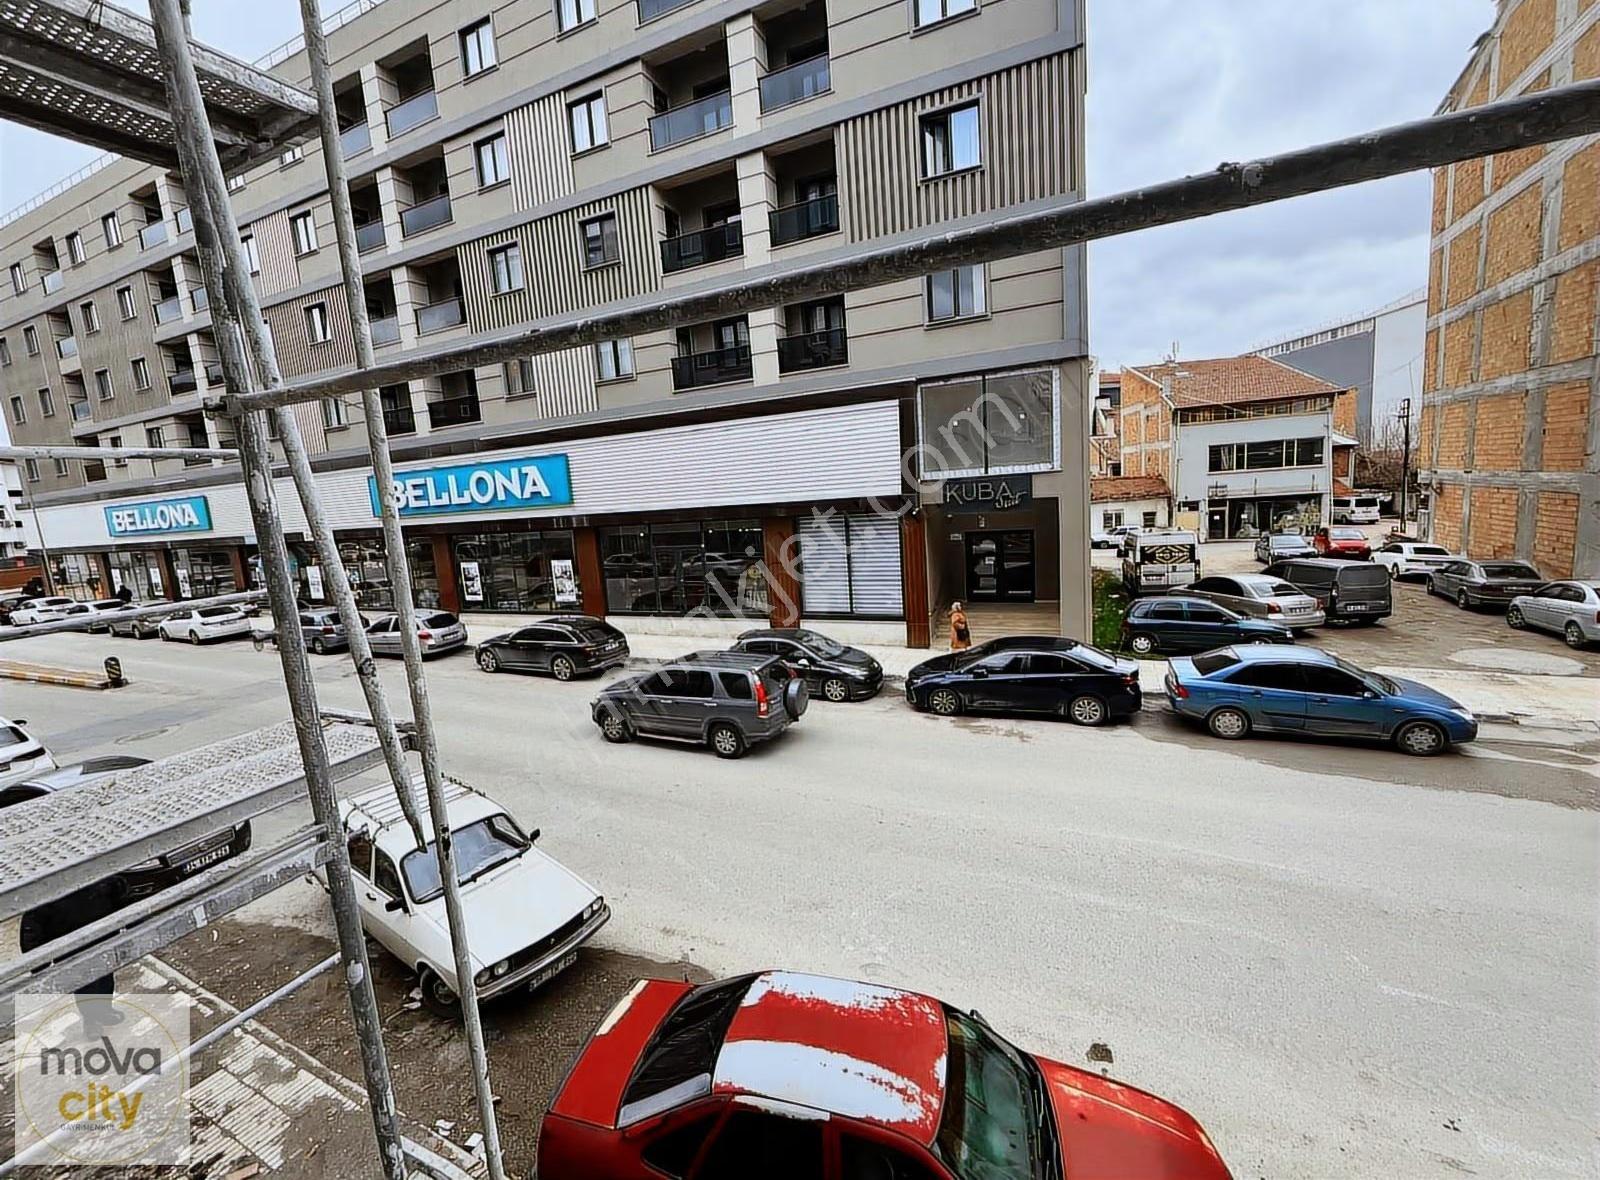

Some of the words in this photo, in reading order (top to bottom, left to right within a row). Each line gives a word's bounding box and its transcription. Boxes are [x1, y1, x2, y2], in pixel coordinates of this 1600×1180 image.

[393, 465, 552, 508] BELLONA
[946, 481, 1014, 504] KUBA
[112, 503, 200, 531] BELLONA
